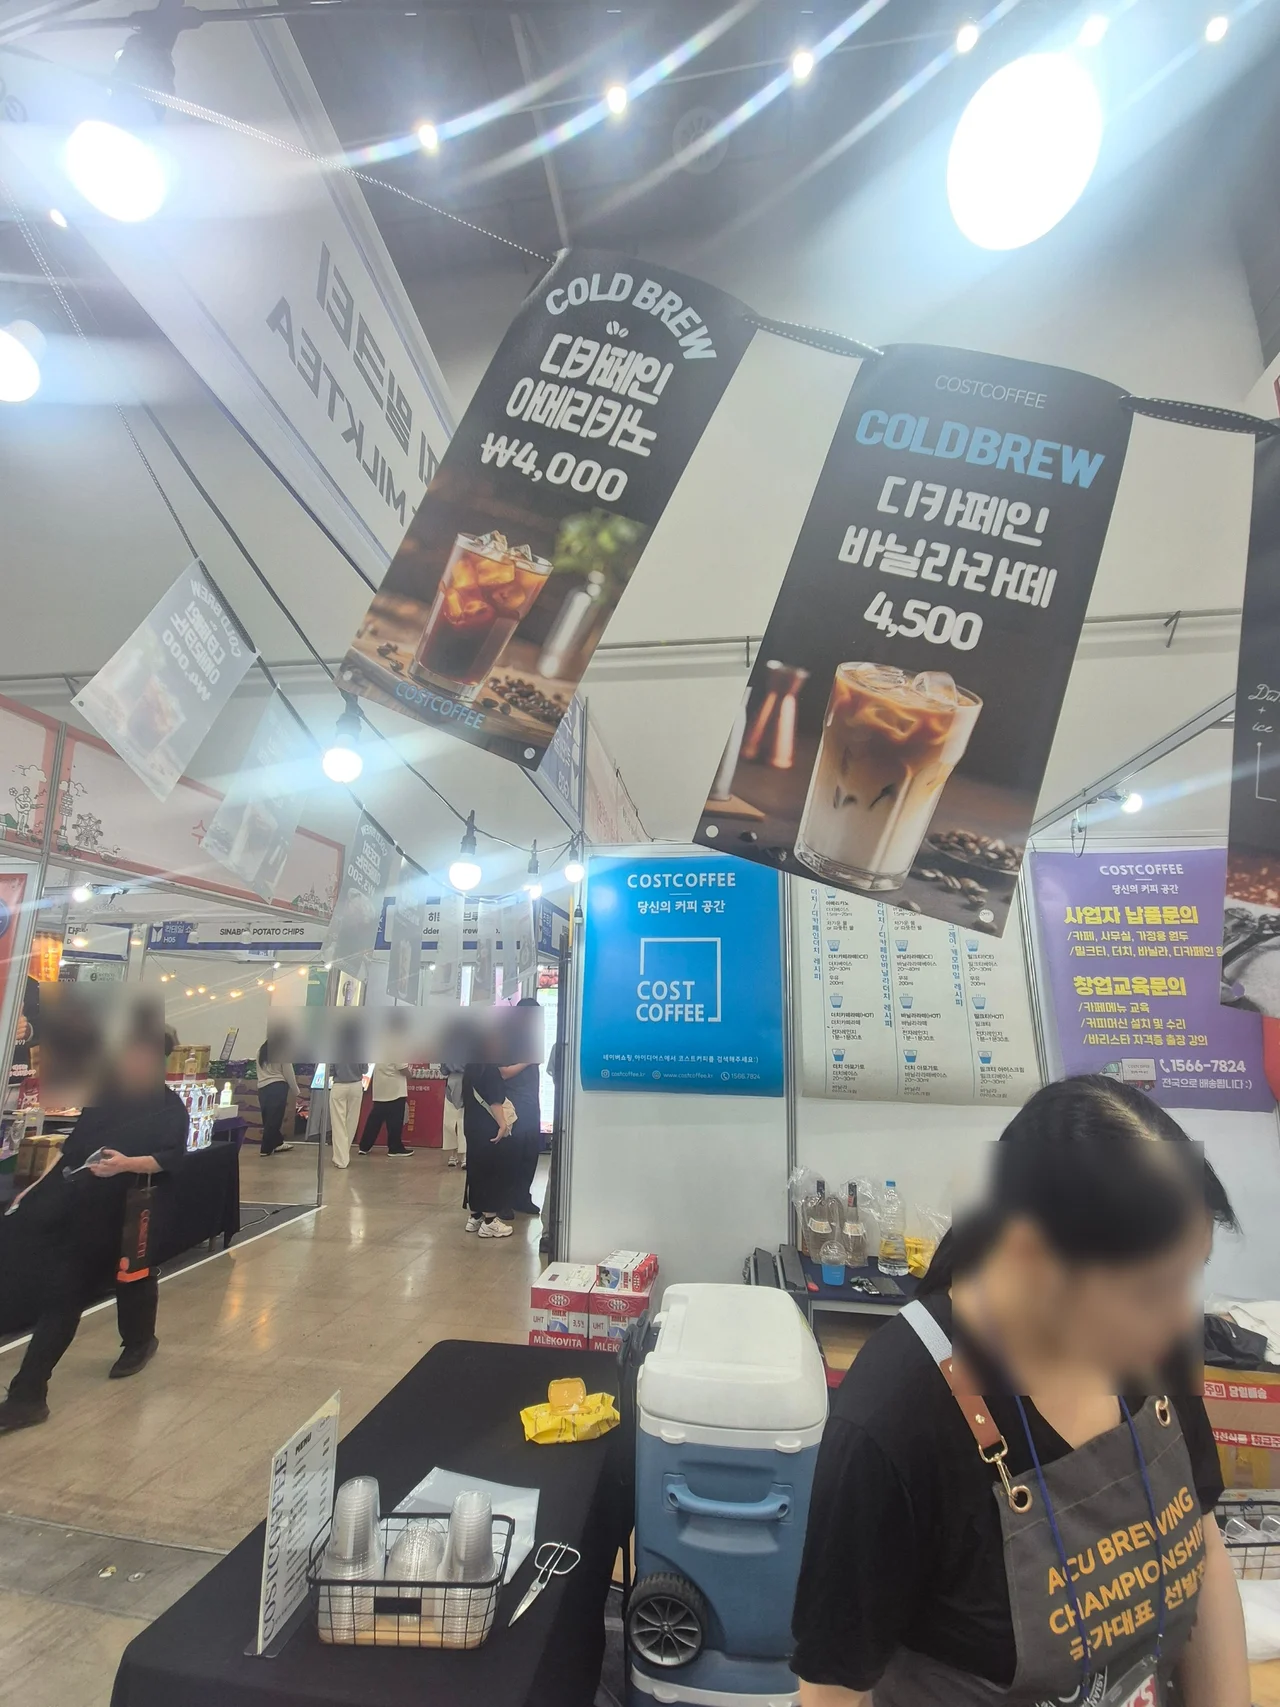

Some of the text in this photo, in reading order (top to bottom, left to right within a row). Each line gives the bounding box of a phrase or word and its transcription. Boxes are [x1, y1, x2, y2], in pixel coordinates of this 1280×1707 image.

[545, 272, 717, 360] COLD BREW
[539, 332, 674, 406] 디카페인
[934, 374, 1048, 409] COSTCOFFEE
[505, 377, 657, 457] 아메리카노
[855, 409, 1105, 489] COLDBREW
[876, 475, 1049, 547] 디카페인
[837, 524, 1057, 609] 바닐라라떼
[862, 591, 984, 651] 4,500
[395, 681, 486, 729] COSTCOFFEE
[1252, 721, 1274, 733] ice
[1099, 863, 1184, 876] COSTCOFFEE
[627, 872, 736, 888] COSTCOFFEE
[1112, 884, 1179, 895] 당신의 커피 공간
[637, 900, 726, 914] 당신의 커피 공간
[1064, 905, 1199, 925] 사업자 납품문의
[252, 928, 281, 936] POTATO
[282, 928, 305, 936] CHIPS
[1136, 930, 1167, 942] 가정용
[1168, 930, 1189, 942] 원두
[1173, 945, 1214, 957] 디카페인
[636, 980, 695, 1000] COST
[1073, 975, 1187, 996] 창업교육문의
[636, 1003, 705, 1022] COFFEE
[1130, 1002, 1150, 1013] 교육
[1130, 1018, 1151, 1029] 설치
[1153, 1018, 1164, 1030] 및
[1166, 1018, 1186, 1030] 수리
[1132, 1034, 1163, 1046] 자격증
[1165, 1034, 1186, 1046] 출장
[1187, 1035, 1208, 1046] 강의
[1170, 1059, 1247, 1073] 1566-7824
[1162, 1078, 1197, 1088] 전국으로
[532, 1315, 545, 1323] UHT
[592, 1322, 605, 1330] UHT
[533, 1335, 582, 1348] MLEKOVITA
[295, 1432, 312, 1456] MENU
[262, 1451, 288, 1642] COSTCOFFEE
[1048, 1486, 1194, 1596] ACU BREWING
